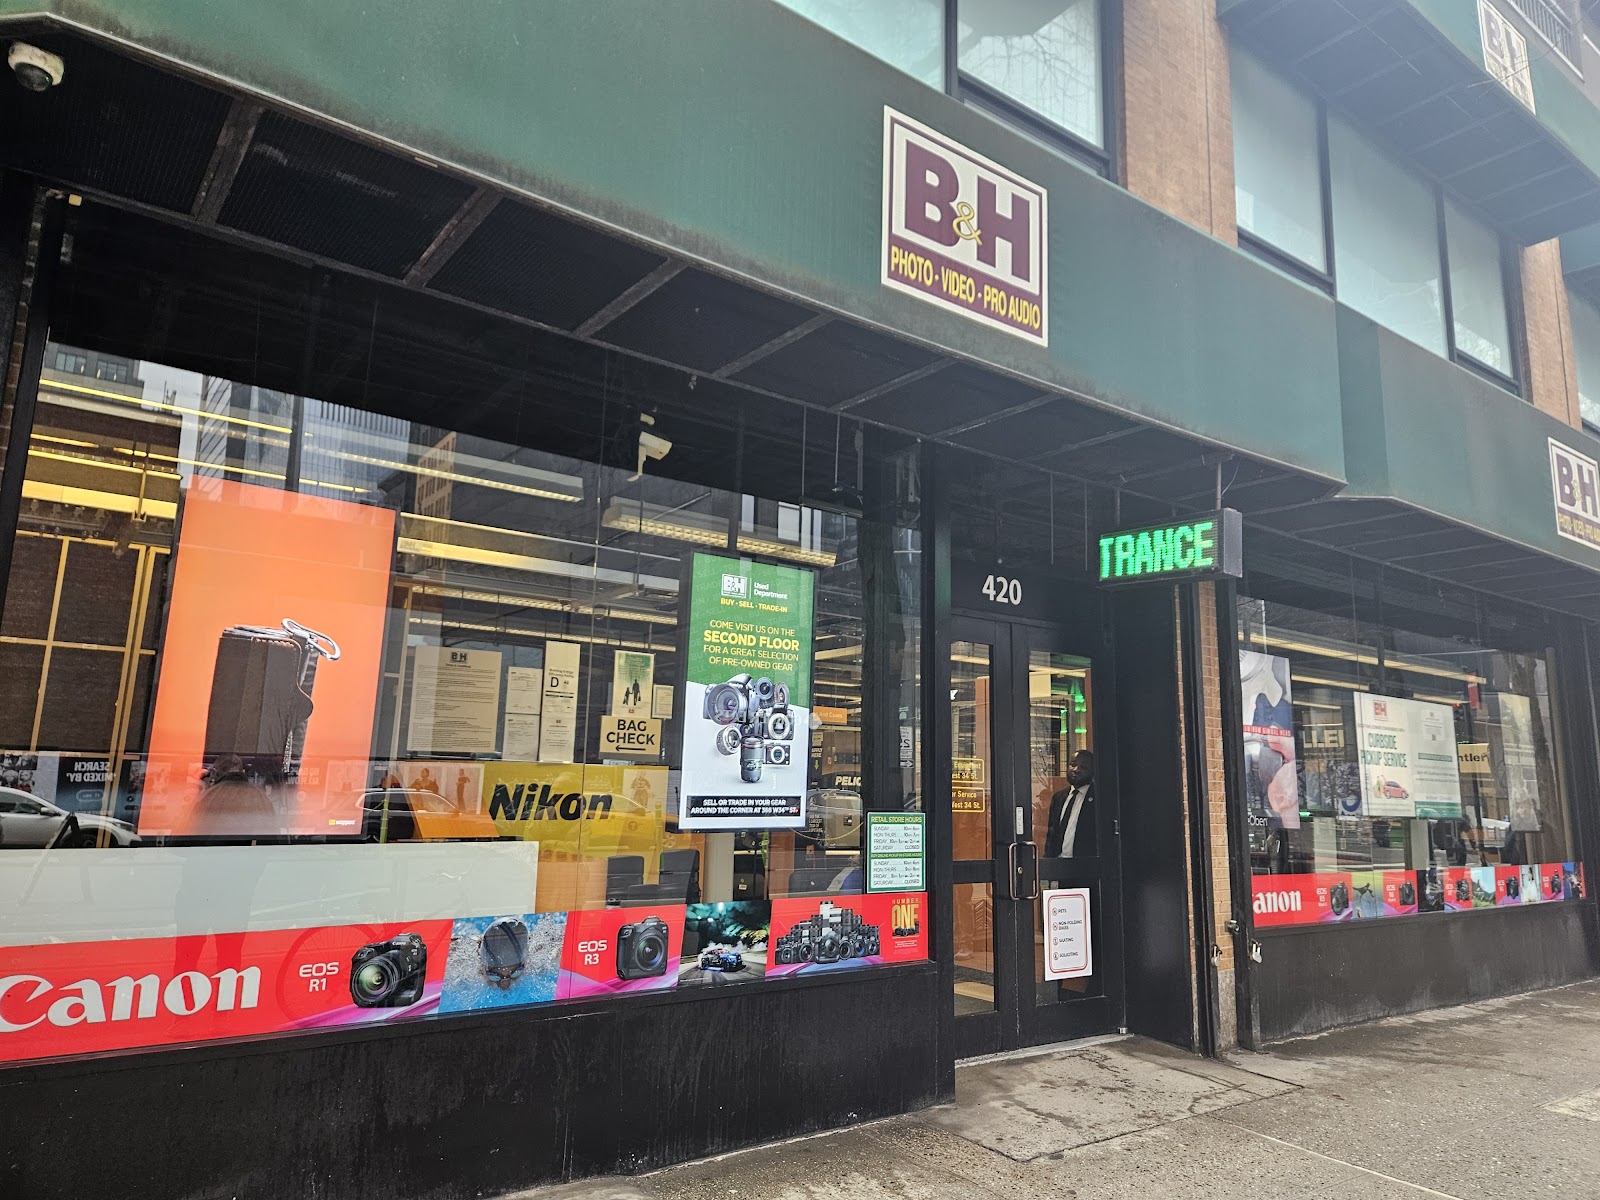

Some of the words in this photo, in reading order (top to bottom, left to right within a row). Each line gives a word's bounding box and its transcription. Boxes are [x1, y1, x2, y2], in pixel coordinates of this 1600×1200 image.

[905, 139, 1030, 283] B&H
[891, 245, 934, 286] PHOTO
[941, 267, 976, 303] VIDEO
[984, 284, 1007, 316] PRO
[1008, 295, 1041, 329] AUDIO
[1556, 453, 1599, 518] B&H
[754, 582, 769, 590] Used
[754, 588, 788, 600] Department
[982, 574, 1022, 605] 420
[721, 597, 735, 606] BUY
[739, 600, 754, 609] SELL
[758, 603, 787, 613] TRADE-IN
[710, 619, 734, 629] COME
[735, 622, 754, 632] VISIT
[755, 626, 766, 634] US
[767, 627, 779, 635] ON
[781, 628, 795, 637] THE
[704, 630, 756, 646] SECOND
[759, 636, 799, 651] FLOOR
[703, 644, 721, 653] FOR
[722, 646, 729, 654] A
[730, 647, 756, 657] GREAT
[758, 651, 799, 661] SELECTION
[708, 656, 722, 665] OF
[722, 657, 771, 670] PRE-OWNED
[772, 663, 793, 671] GEAR
[550, 676, 560, 688] D
[617, 719, 647, 732] BAG
[606, 732, 656, 746] CHECK
[1368, 732, 1397, 750] CURBSIDE
[1361, 749, 1381, 766] PICKUP
[1383, 751, 1407, 768] SERVICE
[489, 783, 613, 821] Nikon
[957, 790, 977, 798] Service
[964, 801, 972, 809] 34
[1249, 815, 1268, 827] Oben
[1252, 890, 1302, 915] anon
[892, 904, 919, 930] ONE
[577, 940, 607, 953] EOS
[584, 953, 600, 966] R3
[299, 961, 339, 978] EOS
[309, 978, 327, 992] R1
[0, 965, 261, 1033] Canon
